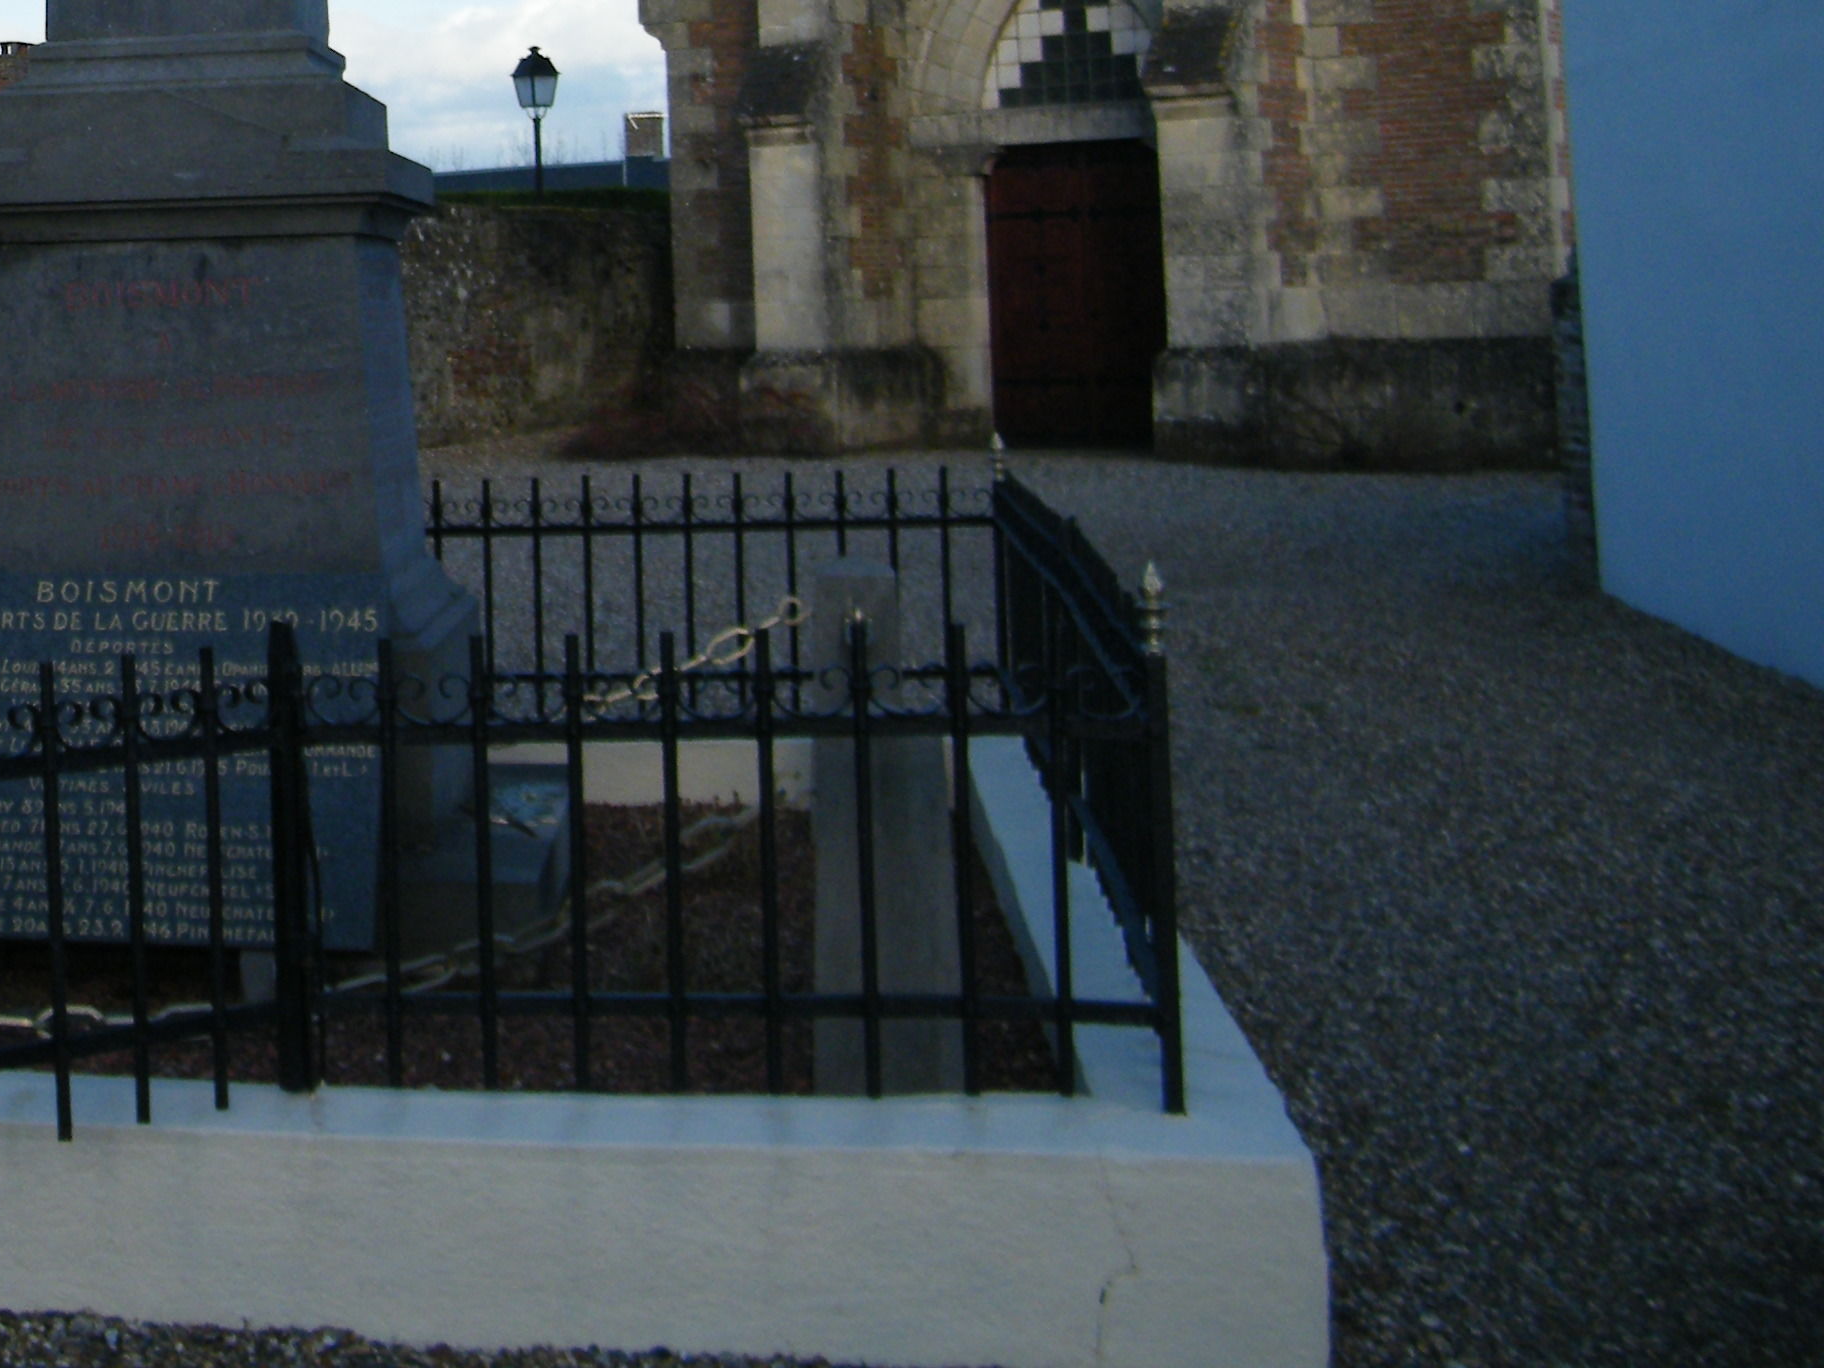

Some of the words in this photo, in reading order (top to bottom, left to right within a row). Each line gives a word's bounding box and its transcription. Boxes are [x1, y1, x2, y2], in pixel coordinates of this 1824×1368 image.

[65, 276, 263, 312] BOISMONT
[37, 579, 219, 604] BOISMONT
[53, 611, 83, 631] DE
[94, 611, 123, 631] LA
[131, 610, 229, 633] GUERRE
[143, 879, 251, 900] NEUFCHTEL
